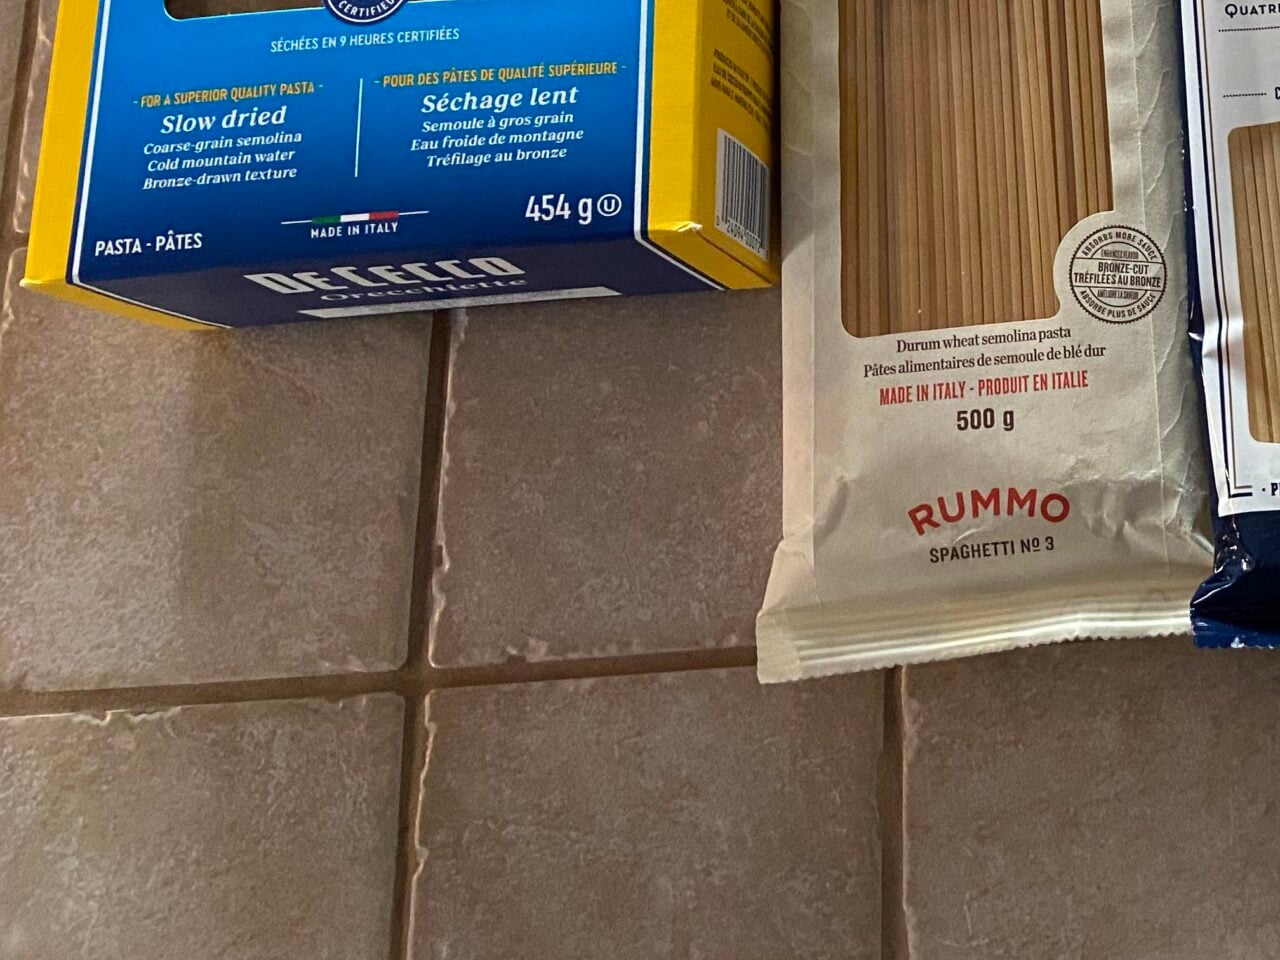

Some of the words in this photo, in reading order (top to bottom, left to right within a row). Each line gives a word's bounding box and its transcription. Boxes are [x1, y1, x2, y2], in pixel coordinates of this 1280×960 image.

[270, 35, 319, 53] SÉCHÉES
[322, 36, 337, 49] EN
[340, 34, 347, 47] 9
[350, 31, 394, 46] HEURES
[396, 25, 460, 43] CERTIFIÉES
[421, 90, 524, 113] Séchage
[530, 86, 579, 104] lent
[160, 114, 216, 134] Slow
[222, 105, 287, 129] dried
[410, 138, 438, 152] Eau
[441, 134, 486, 149] froide
[488, 133, 506, 146] de
[508, 128, 584, 145] montagne
[147, 157, 178, 172] Cold
[181, 152, 252, 170] mountain
[255, 149, 295, 163] water
[524, 194, 572, 222] 454
[578, 198, 593, 225] g
[95, 237, 143, 257] PASTA
[155, 230, 203, 252] PÂTES
[310, 225, 342, 239] MADE
[346, 224, 360, 237] IN
[364, 221, 399, 235] ITALY
[1074, 270, 1116, 285] TRÉFILÉES
[1117, 275, 1128, 286] AU
[1130, 276, 1161, 288] BRONZE
[1098, 262, 1149, 275] BRONZE-CUT
[896, 338, 941, 354] Durum
[943, 333, 981, 349] wheat
[981, 328, 1037, 345] semolina
[1038, 326, 1071, 343] pasta
[880, 387, 913, 406] MADE
[916, 385, 929, 401] IN
[933, 381, 966, 400] ITALY
[978, 376, 1029, 397] PRODUIT
[1033, 374, 1048, 391] EN
[1051, 370, 1088, 389] ITALIE
[956, 407, 996, 430] 500
[1003, 409, 1015, 431] g
